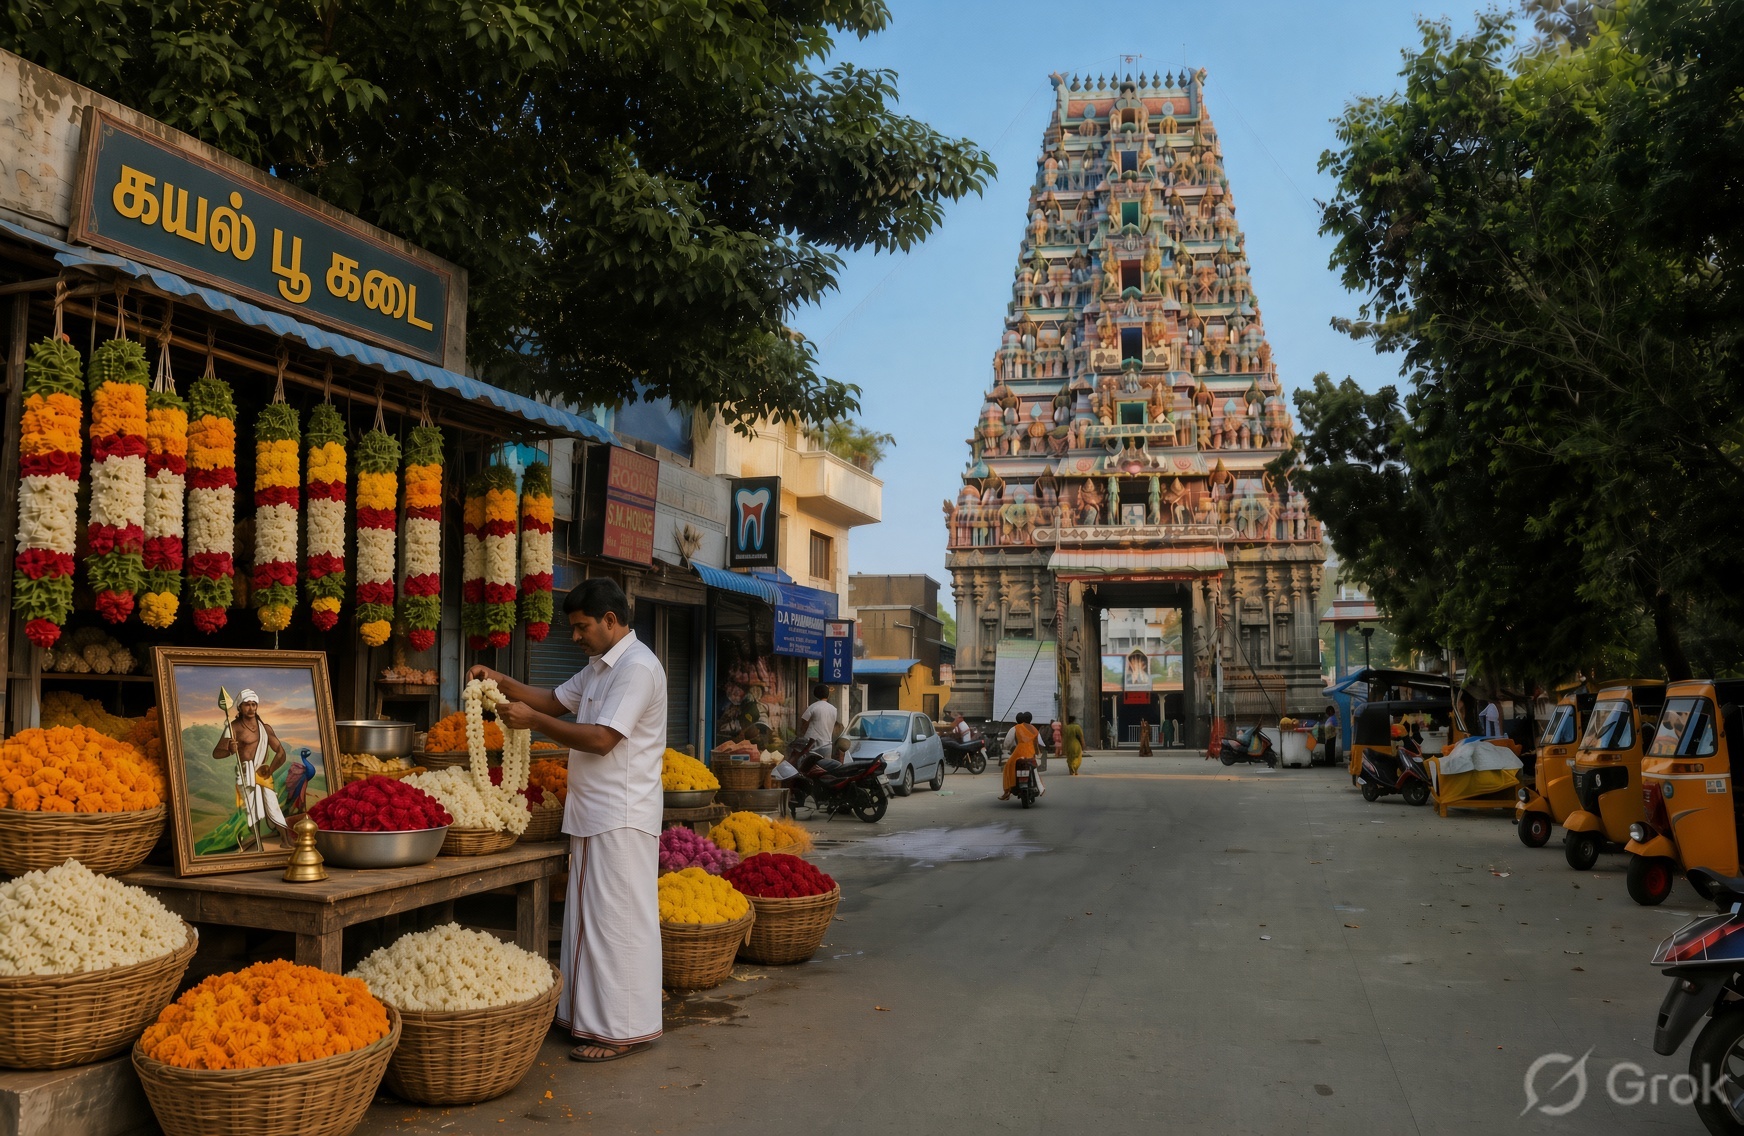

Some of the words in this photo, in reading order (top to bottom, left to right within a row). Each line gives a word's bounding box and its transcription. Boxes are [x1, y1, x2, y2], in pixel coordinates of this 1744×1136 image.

[112, 164, 257, 261] கயல்
[271, 228, 312, 304] பூ
[325, 252, 433, 332] கடை
